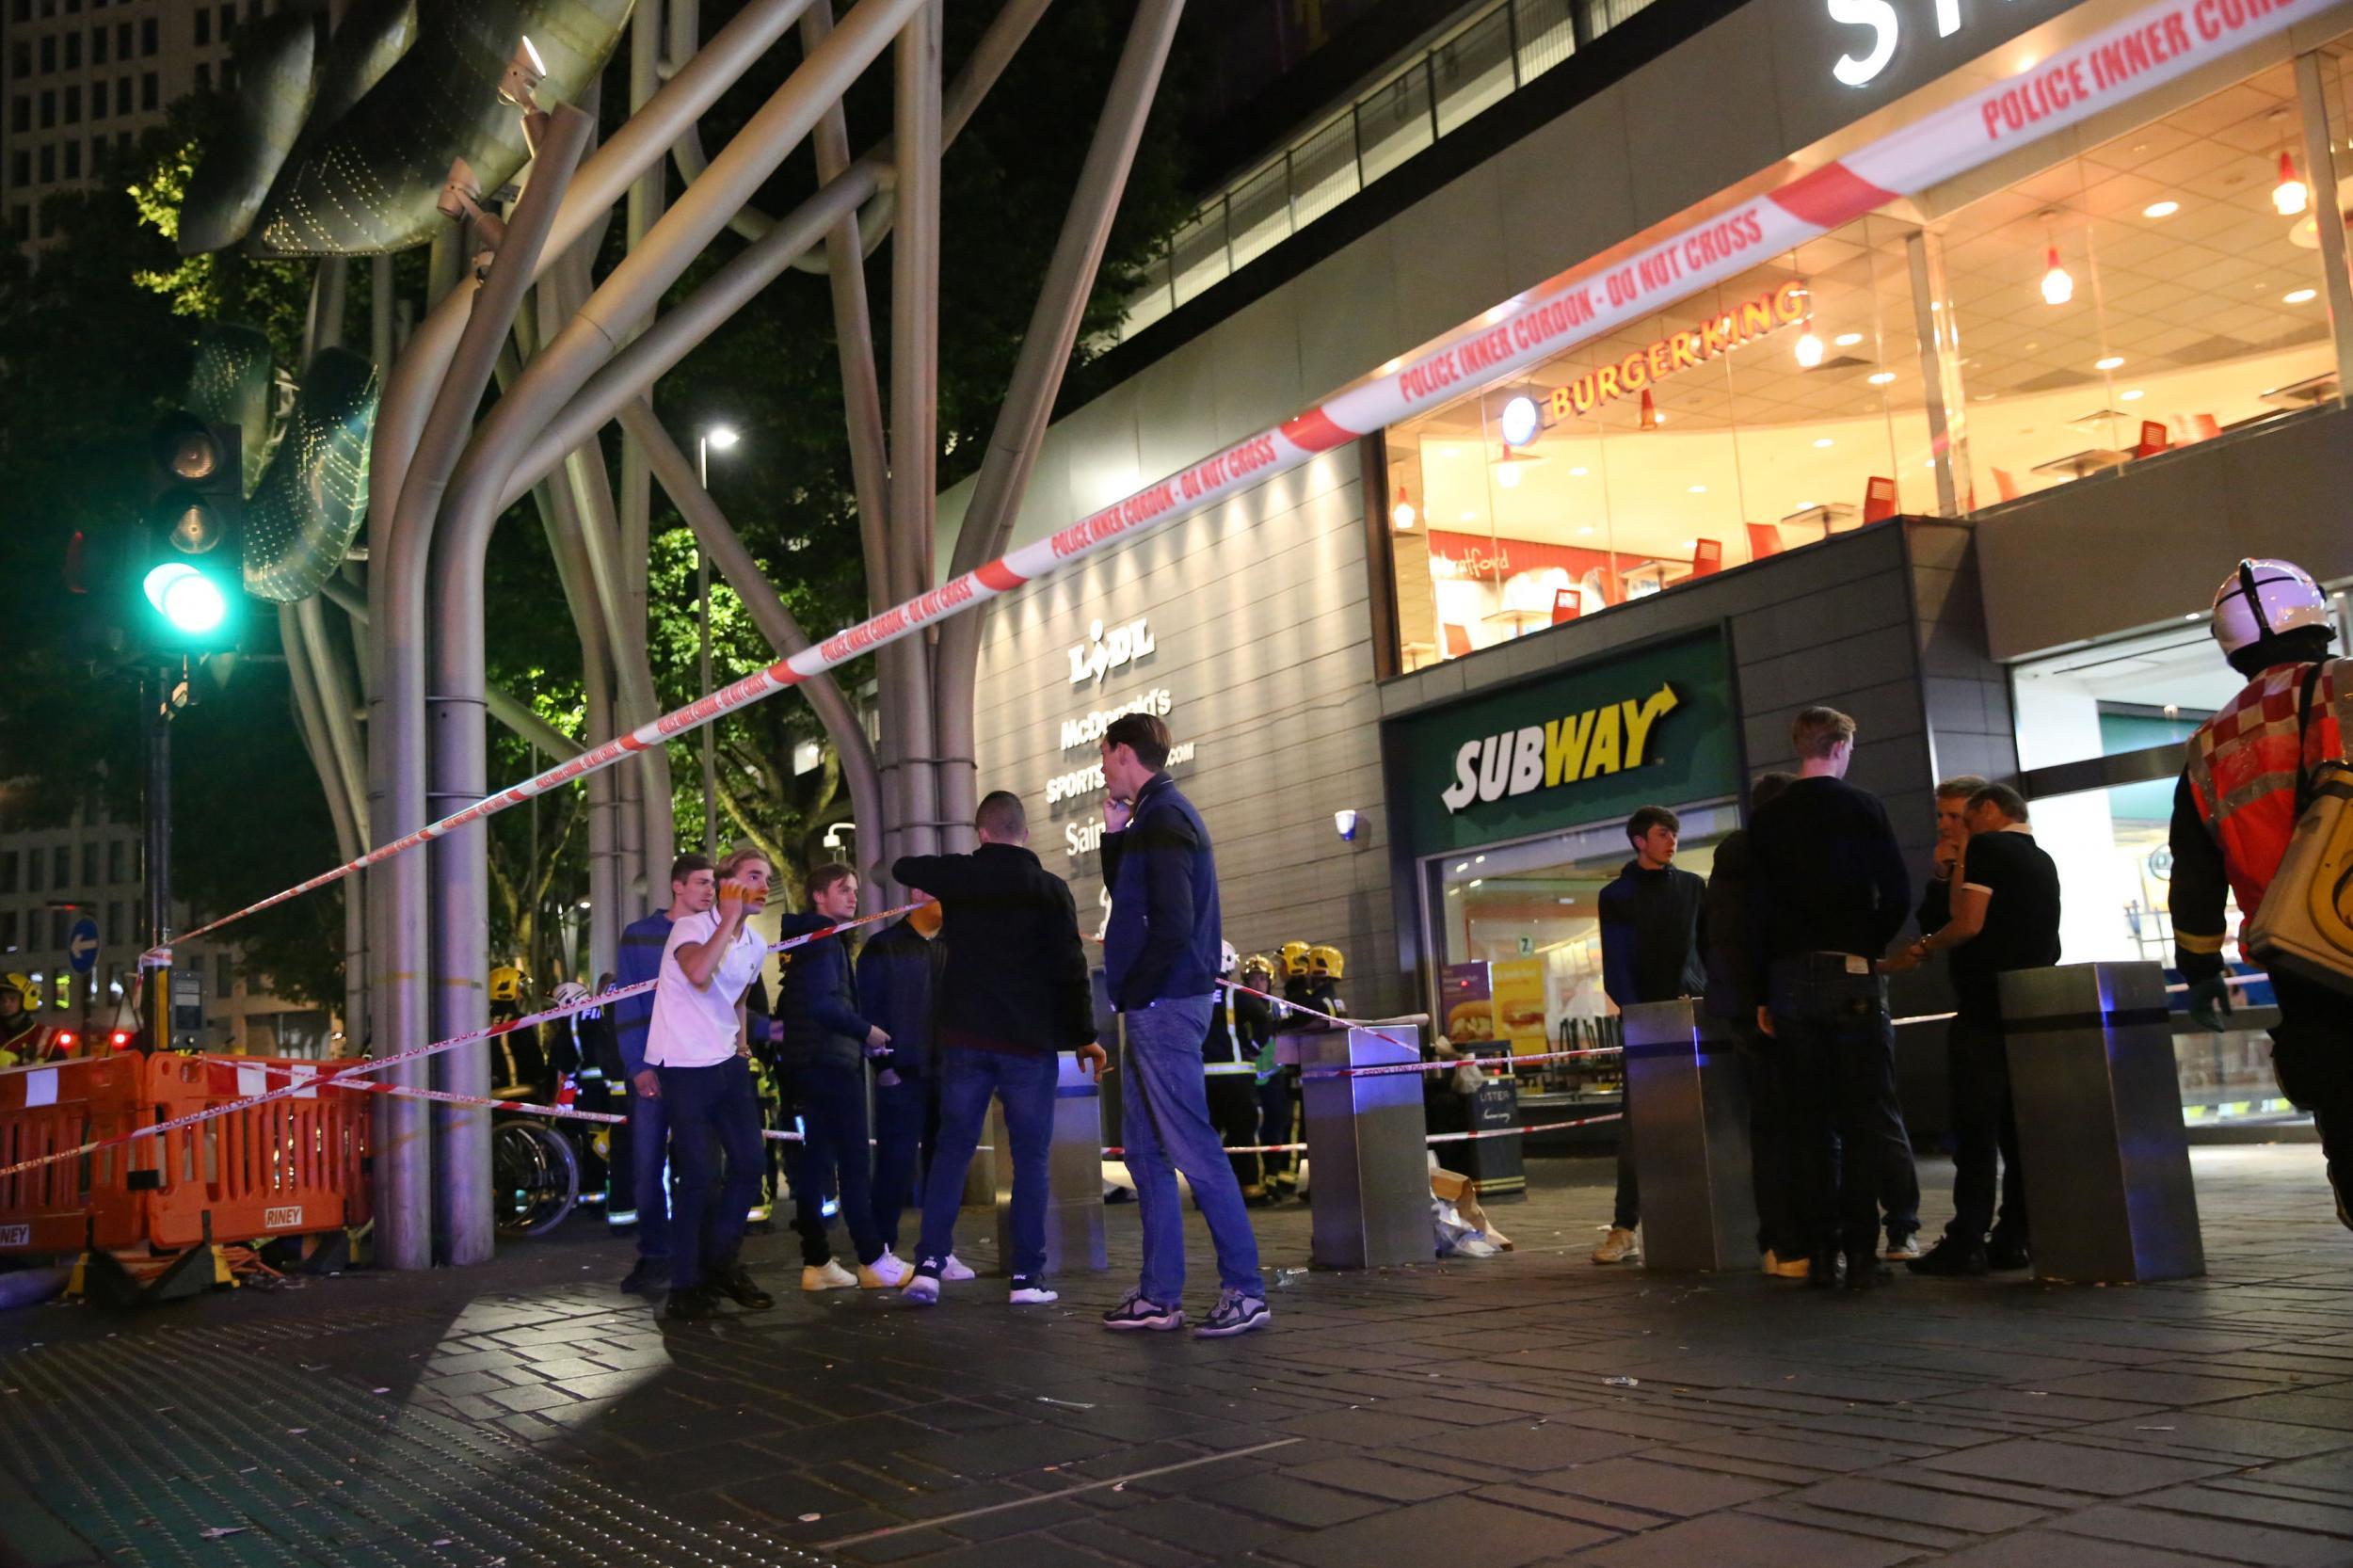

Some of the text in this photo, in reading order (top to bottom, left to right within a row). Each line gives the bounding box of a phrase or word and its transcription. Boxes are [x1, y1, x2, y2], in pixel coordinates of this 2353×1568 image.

[1982, 69, 2089, 140] POLICE
[2089, 11, 2191, 91] INNER
[1399, 351, 1461, 403] POLICE
[1462, 326, 1515, 377] INNER
[1513, 294, 1595, 351] CORDON
[1606, 272, 1638, 310] DO
[1639, 245, 1682, 292] NOT
[1680, 208, 1763, 272] CROSS
[1550, 281, 1806, 422] BURGER KING
[1050, 522, 1092, 559] POLICE
[1226, 435, 1277, 478] CROSS
[1442, 681, 1679, 815] SUBWAY
[266, 1208, 300, 1225] RINEY
